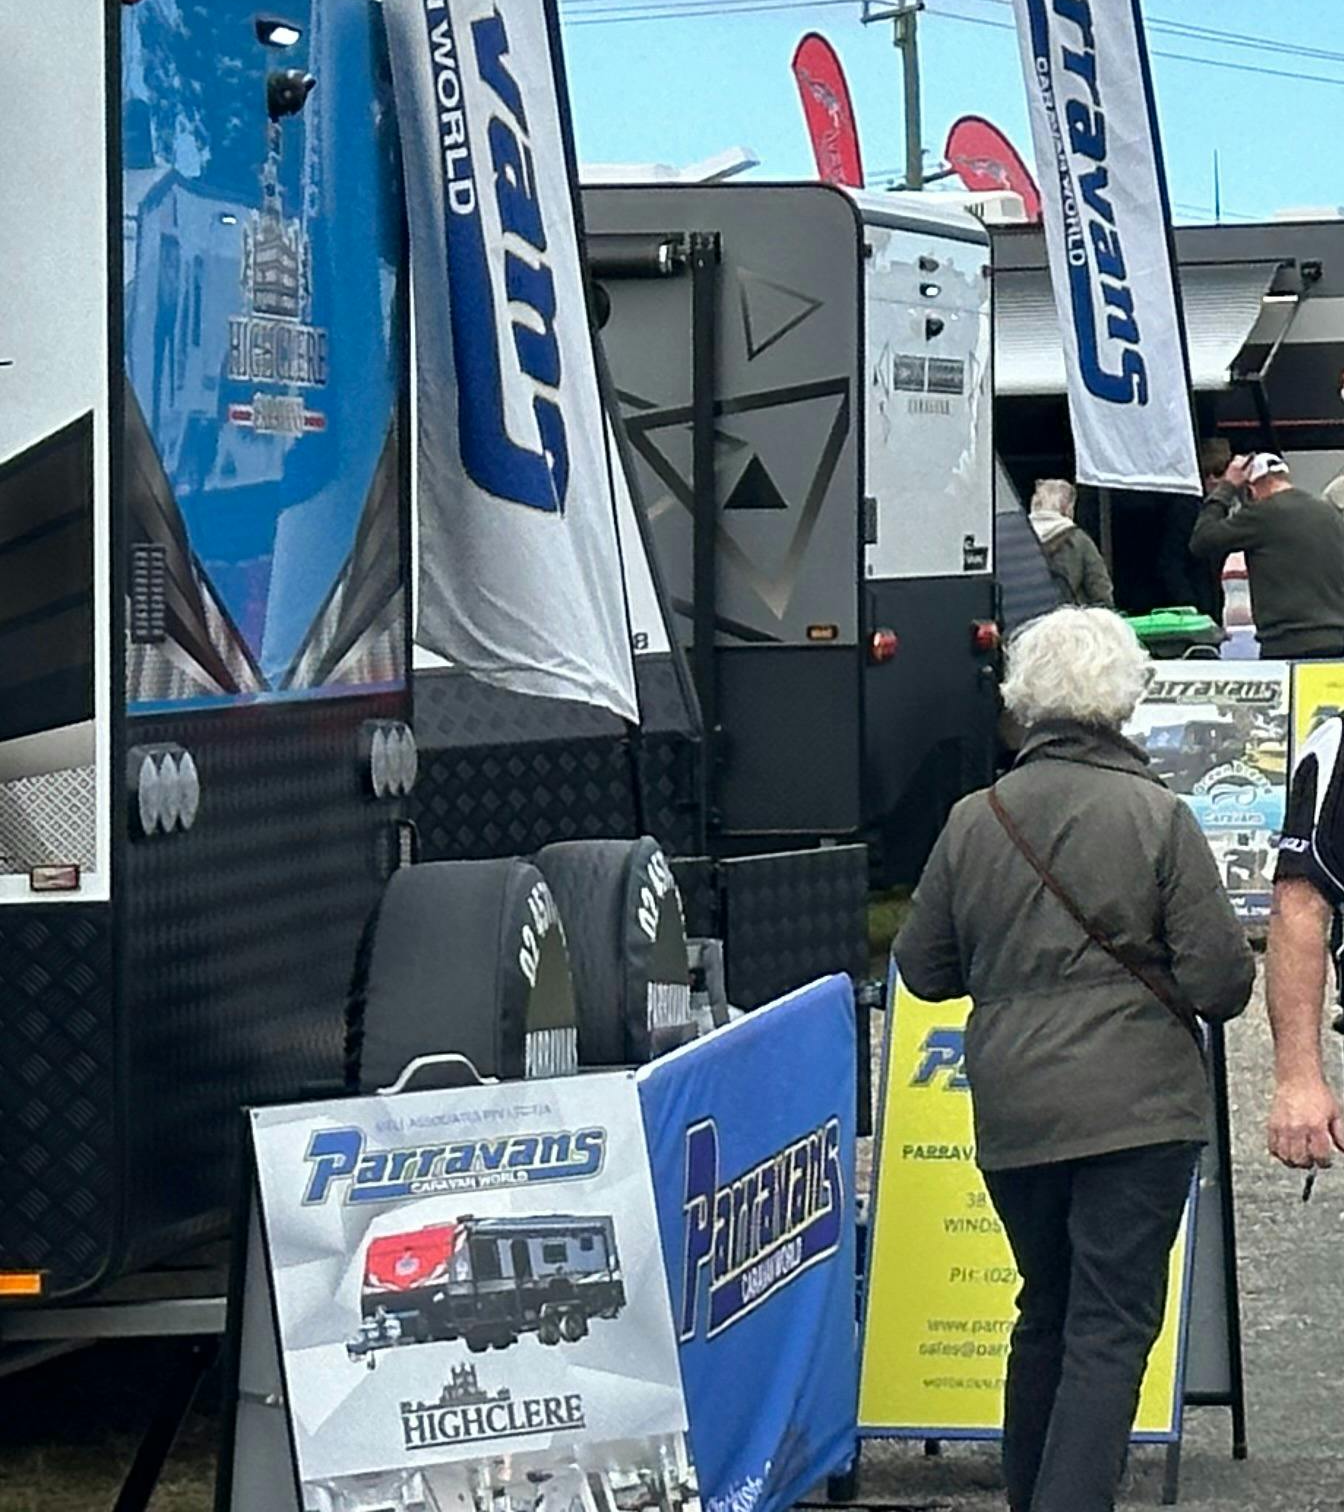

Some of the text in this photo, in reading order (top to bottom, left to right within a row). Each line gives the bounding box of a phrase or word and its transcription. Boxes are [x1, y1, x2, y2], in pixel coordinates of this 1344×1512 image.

[428, 21, 478, 216] WORLD
[1144, 670, 1283, 705] arravans
[301, 1125, 608, 1207] Parravans
[410, 1169, 530, 1195] CARAVAN WORLD
[680, 1115, 843, 1341] Parravans
[401, 1393, 585, 1445] HIGHCLERE
